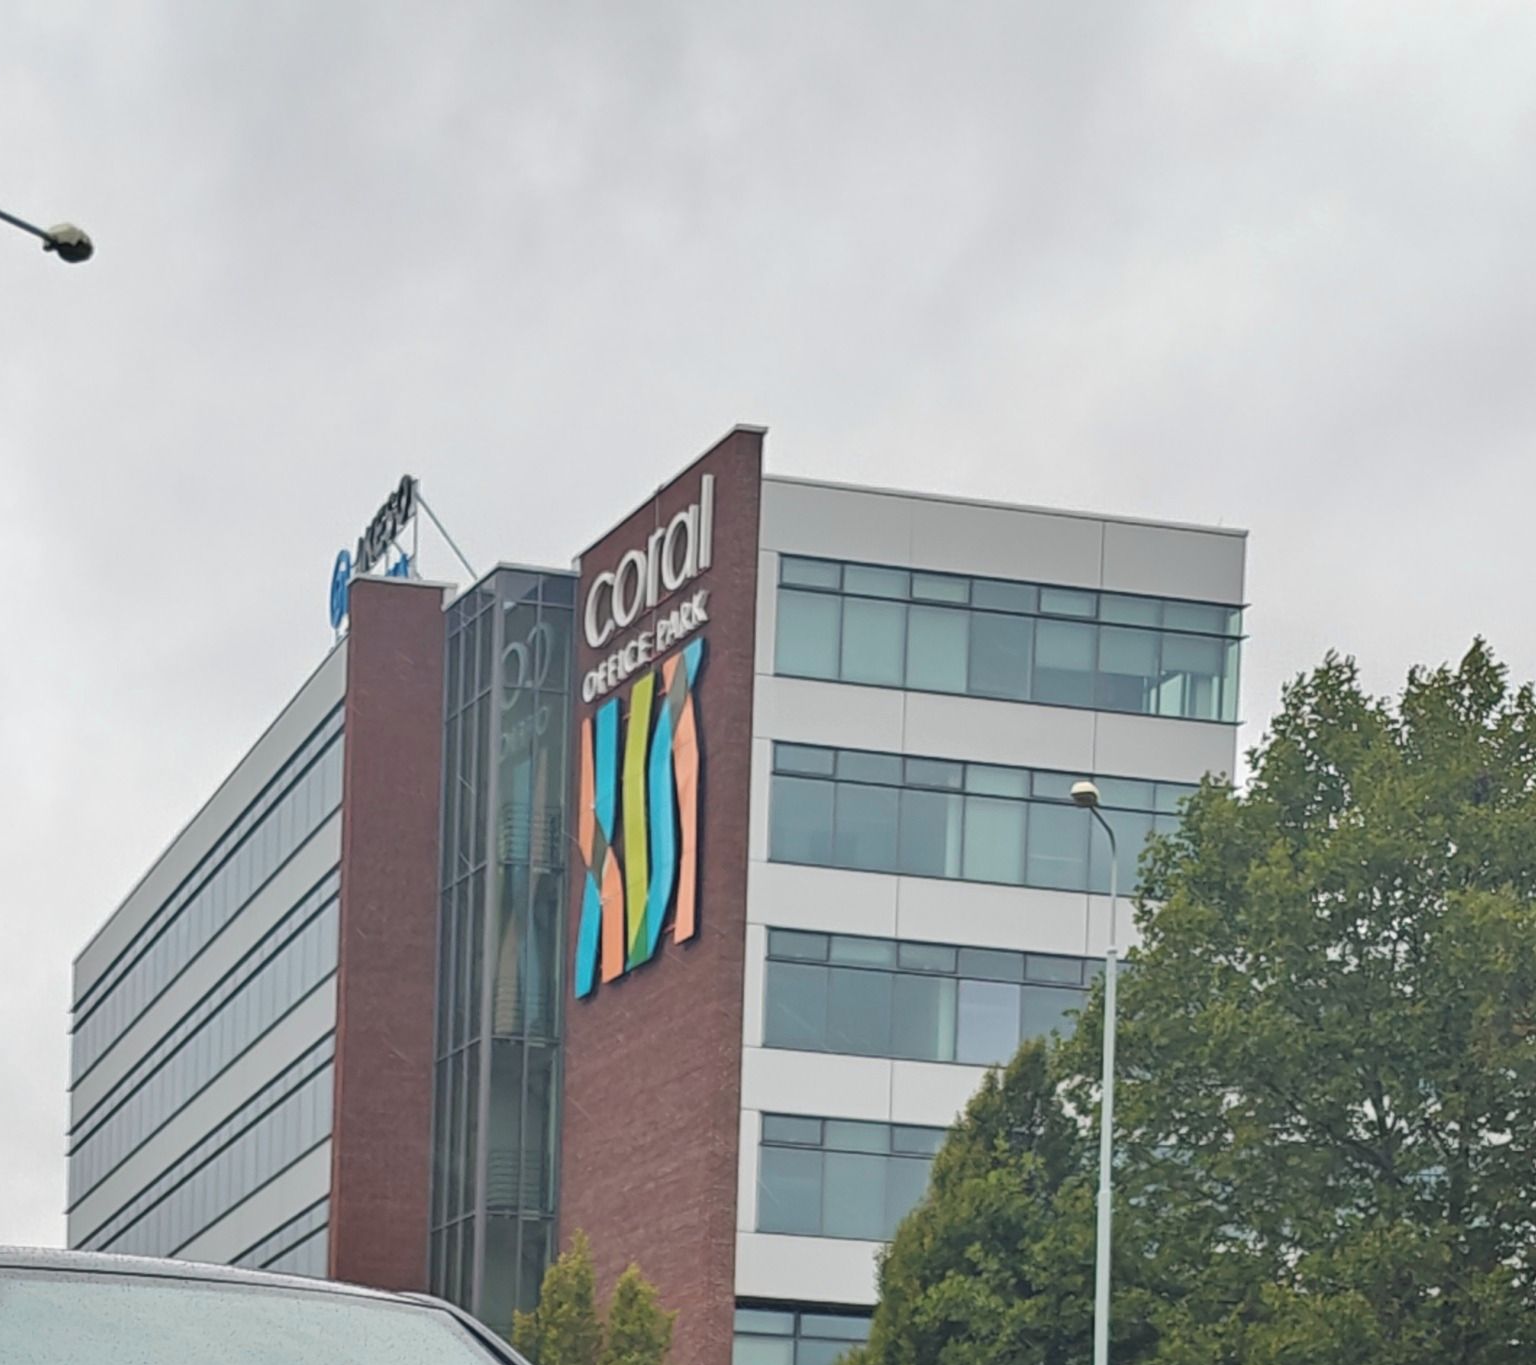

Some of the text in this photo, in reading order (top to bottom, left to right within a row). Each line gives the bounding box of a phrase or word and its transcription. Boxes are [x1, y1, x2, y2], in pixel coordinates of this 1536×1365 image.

[584, 473, 714, 648] coral
[582, 631, 654, 703] OFFICE
[657, 589, 709, 652] PARK
